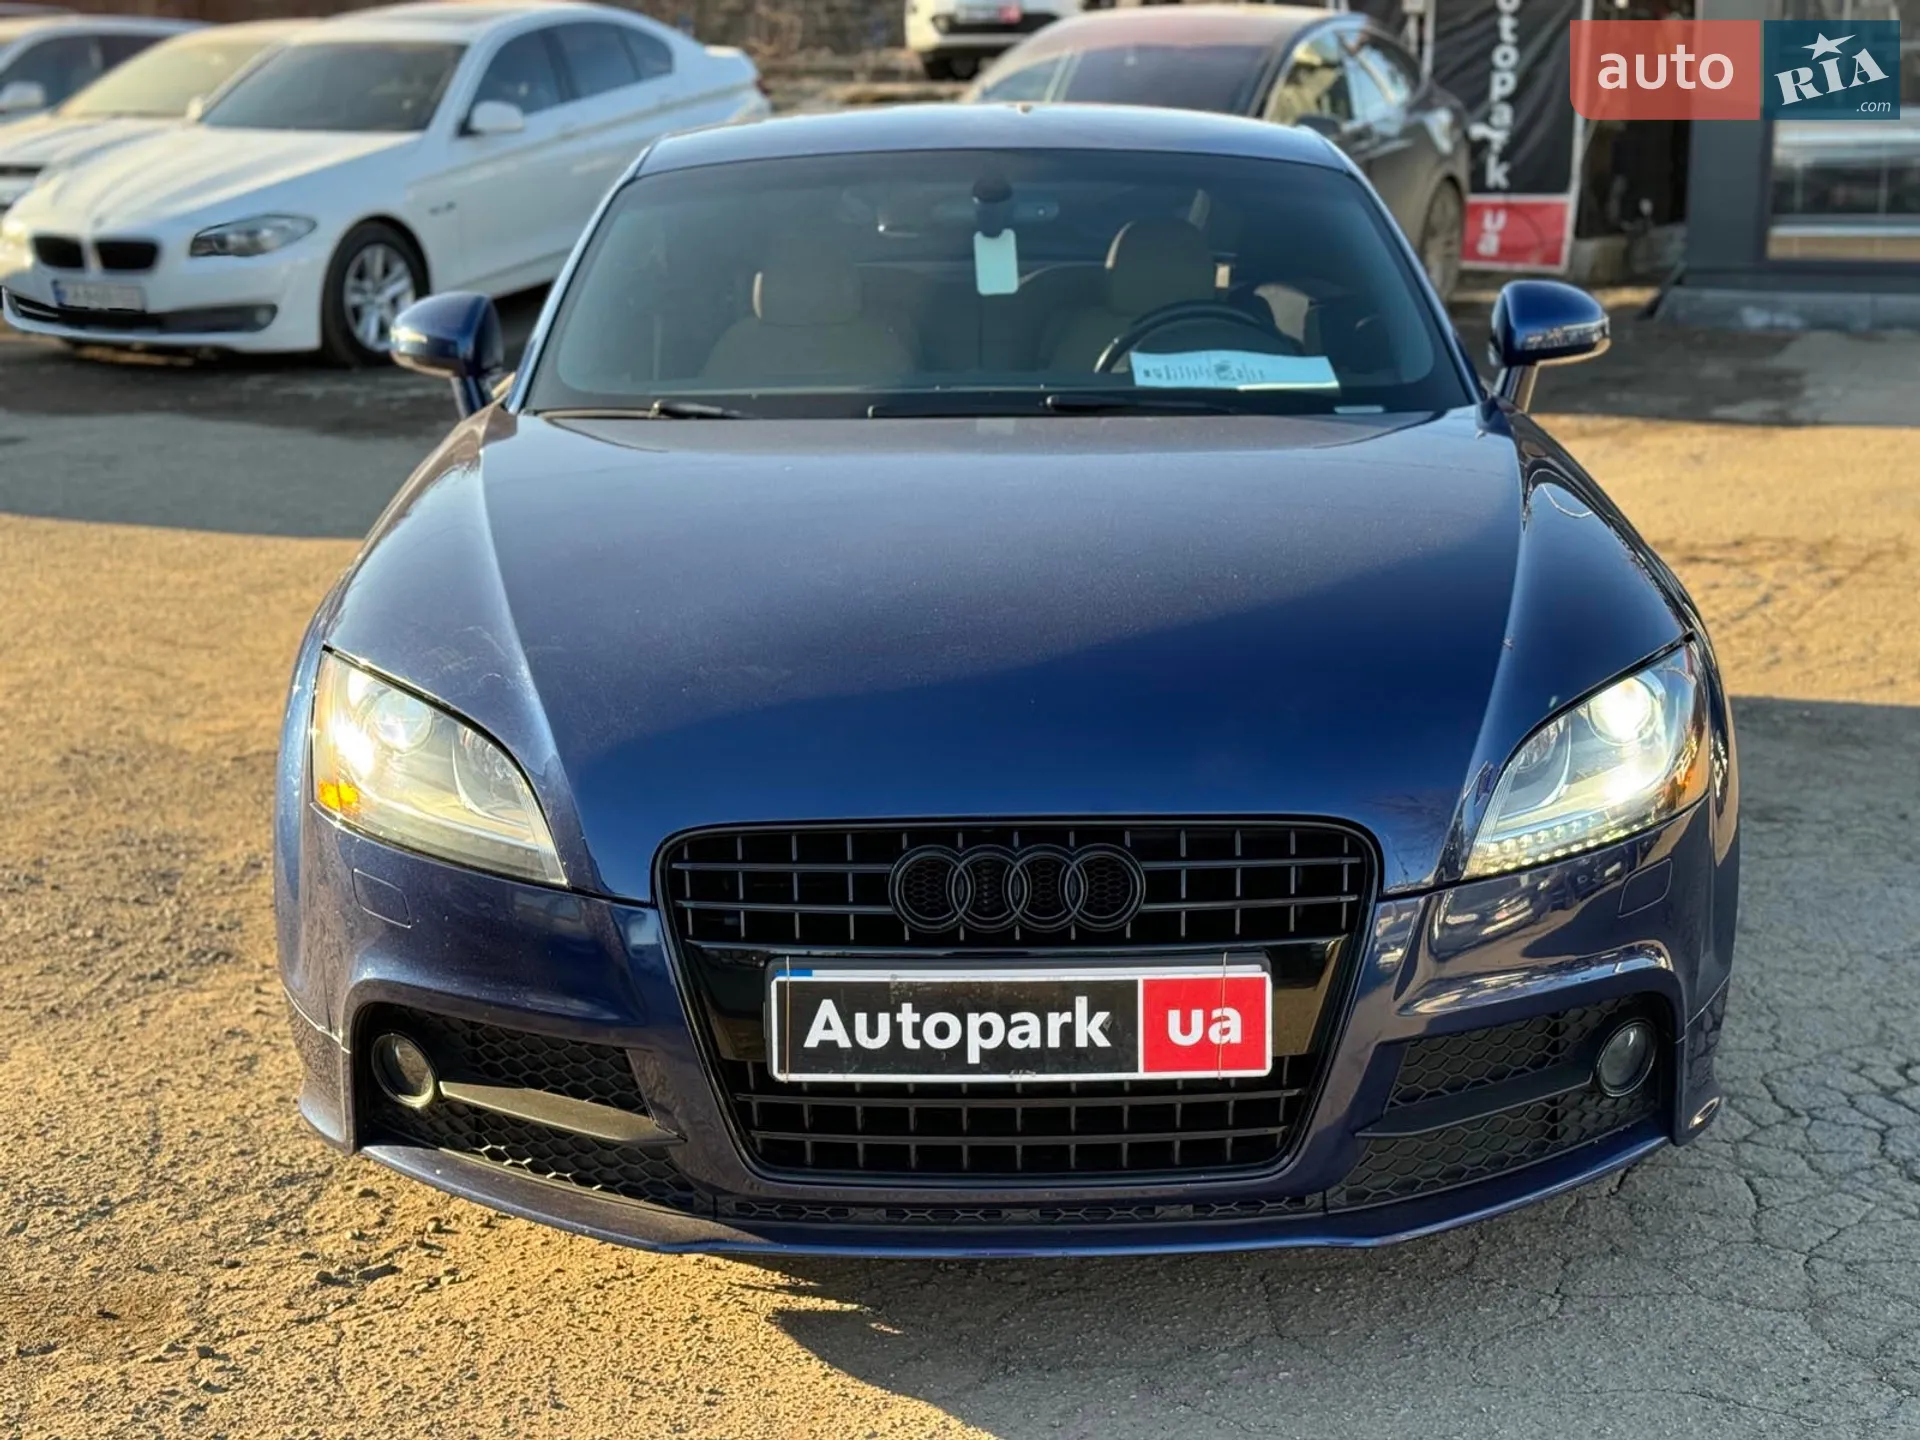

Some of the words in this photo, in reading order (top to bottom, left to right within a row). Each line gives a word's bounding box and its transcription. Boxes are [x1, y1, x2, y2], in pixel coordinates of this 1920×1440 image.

[1477, 210, 1506, 256] ua
[804, 996, 1111, 1064] Autopark
[1167, 1007, 1242, 1046] ua
